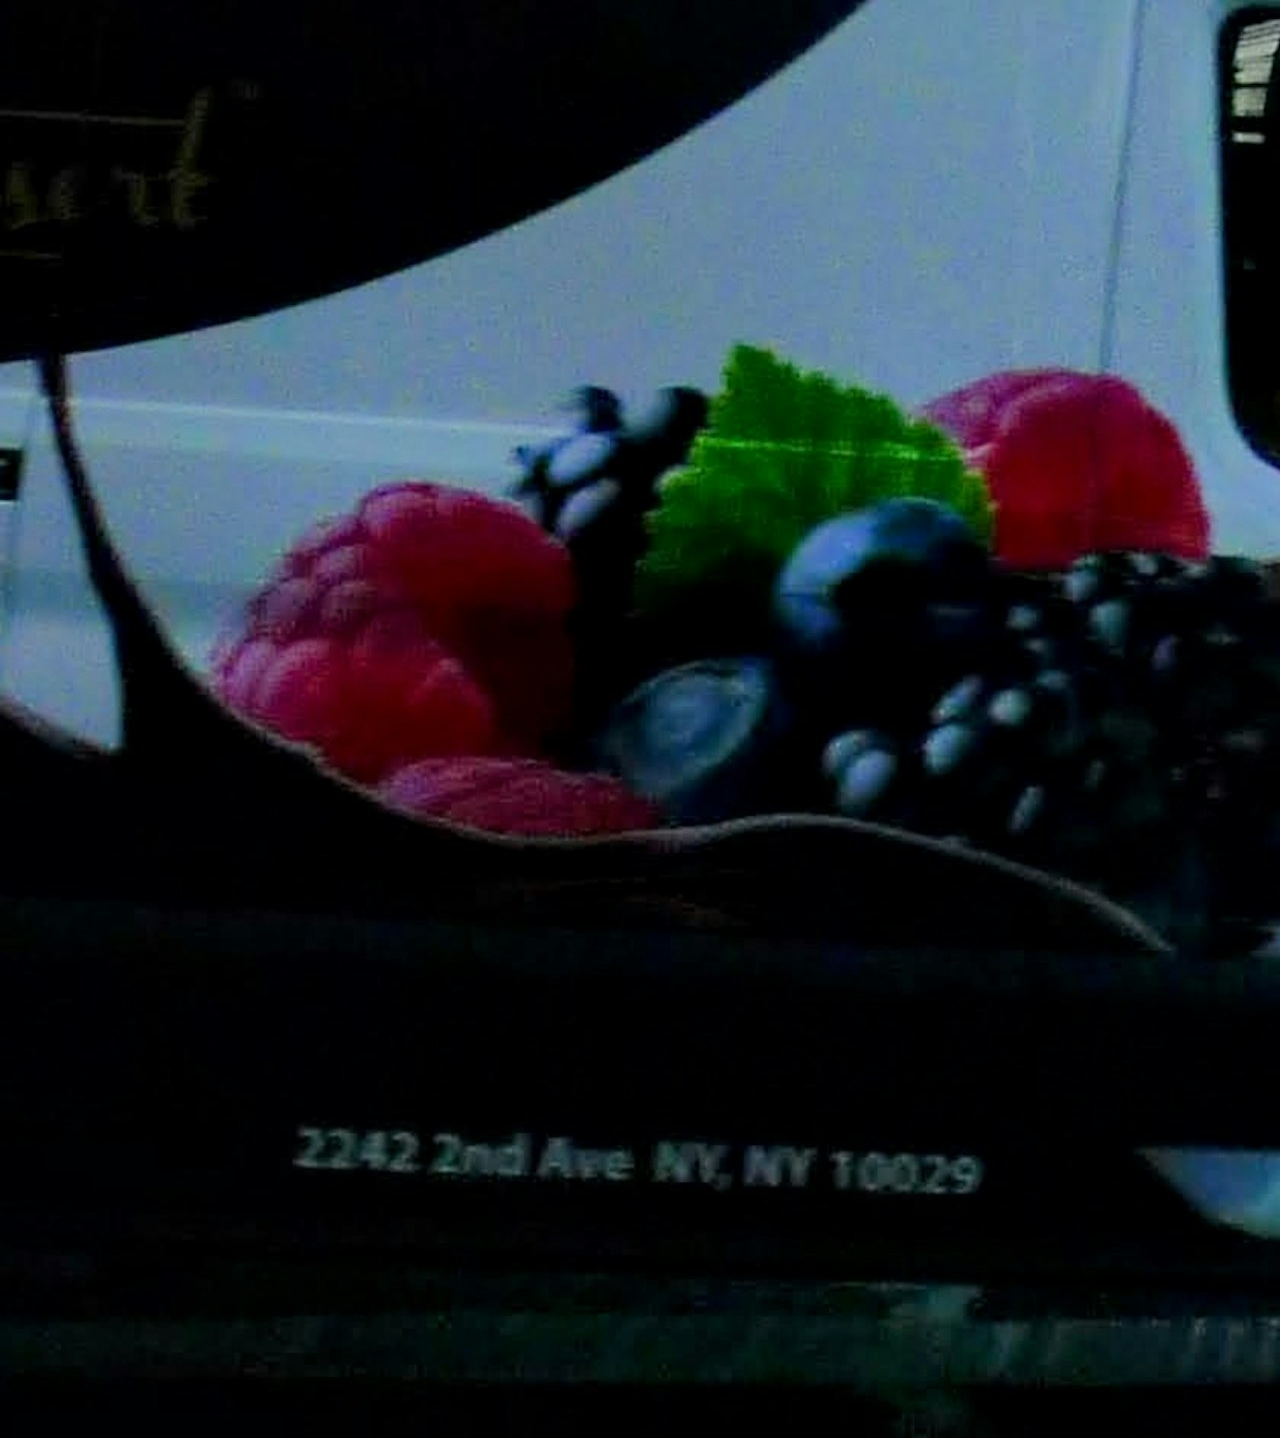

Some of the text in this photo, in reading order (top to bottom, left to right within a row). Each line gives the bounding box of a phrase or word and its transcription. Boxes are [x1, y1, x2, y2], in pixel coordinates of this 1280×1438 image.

[293, 1126, 983, 1195] 2242 2nd Ave NY, NY 10029
